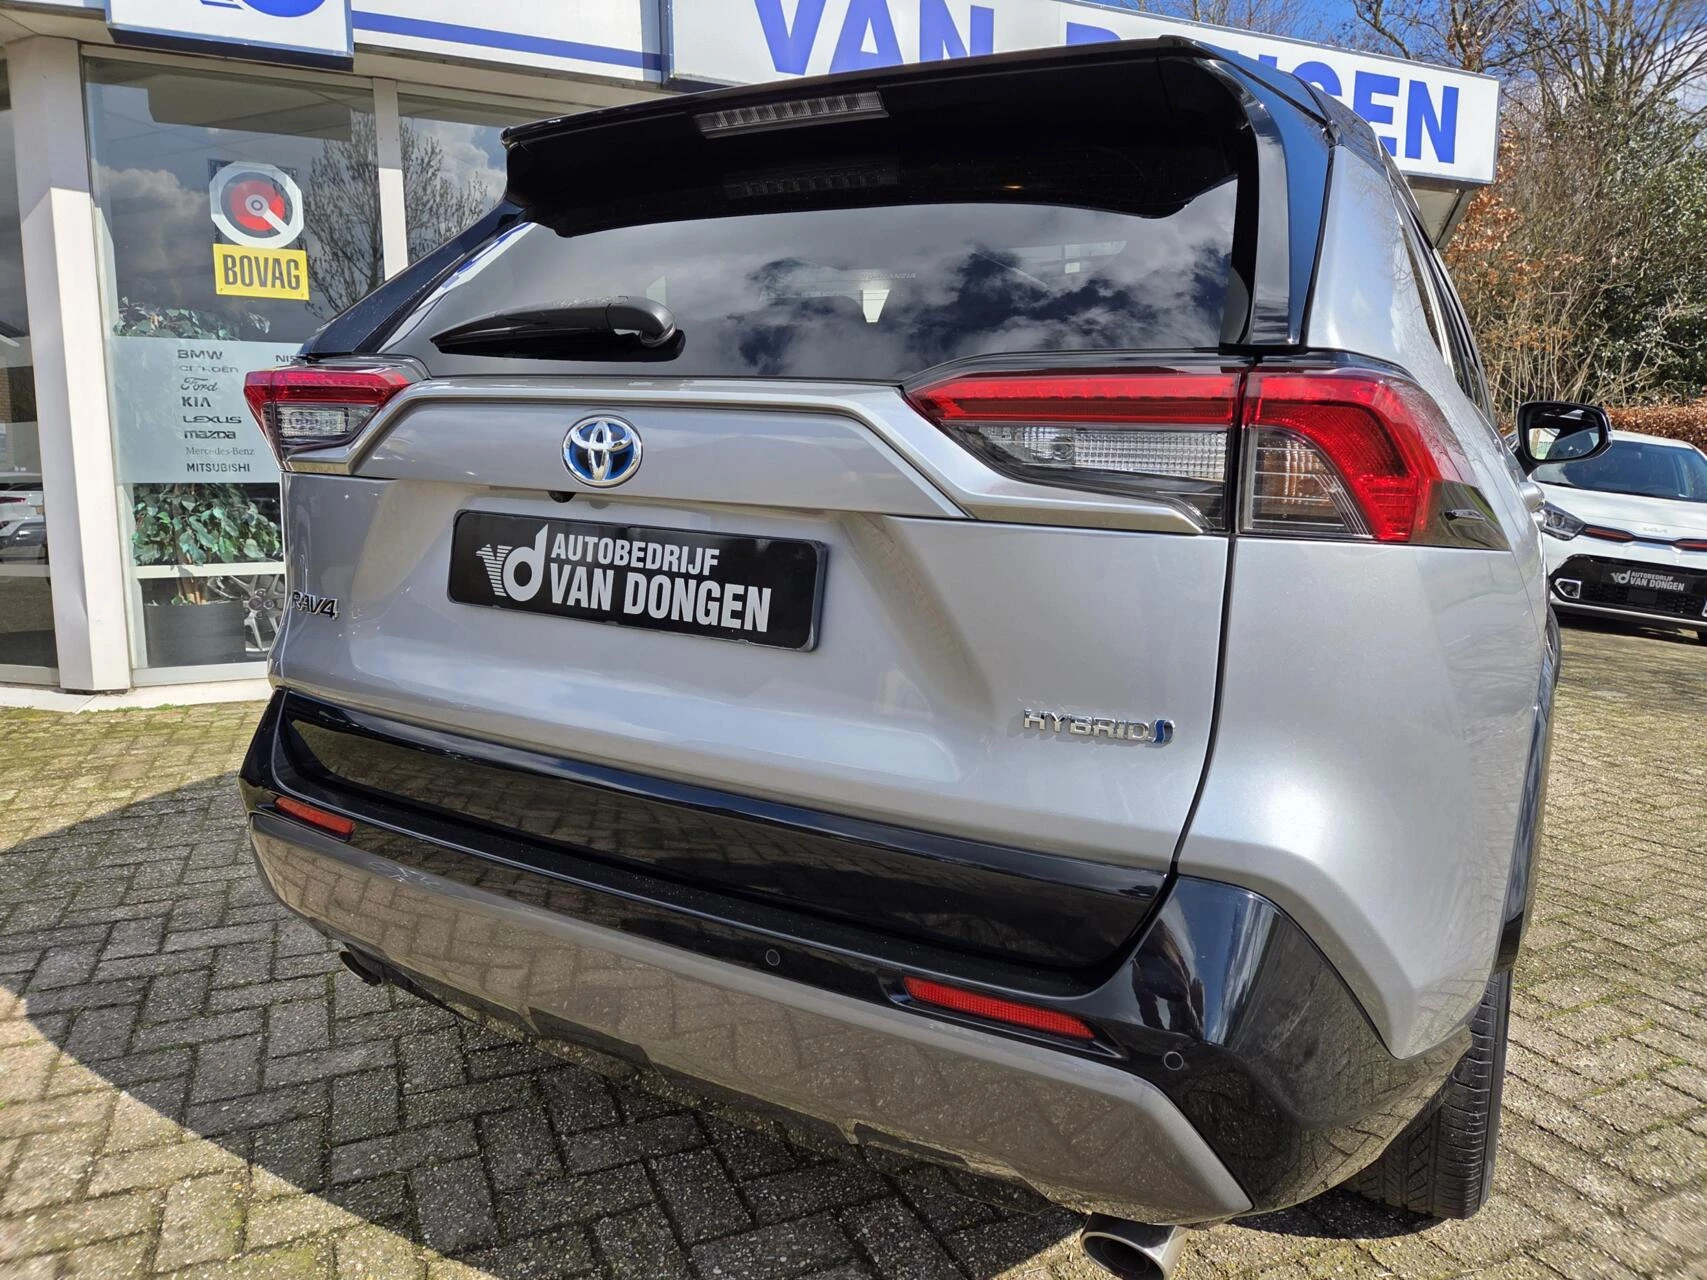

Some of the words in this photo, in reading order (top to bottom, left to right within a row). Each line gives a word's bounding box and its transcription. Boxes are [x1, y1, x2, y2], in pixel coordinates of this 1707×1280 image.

[755, 0, 994, 75] VAN
[222, 254, 300, 290] BOVAG
[177, 349, 222, 360] BMW
[180, 376, 218, 391] Ford
[182, 396, 211, 408] KIA
[183, 415, 242, 424] LEXUS
[187, 463, 250, 472] MITSUBISHI
[551, 533, 720, 576] AUTOBEDRIJF
[1631, 571, 1674, 581] AUTOBEDRIJF
[1630, 577, 1648, 586] VAN
[1649, 579, 1685, 591] DONGEN
[292, 590, 339, 620] RAV4
[550, 562, 614, 612] VAN
[623, 572, 772, 633] DONGEN
[1024, 708, 1149, 741] HYBRID
